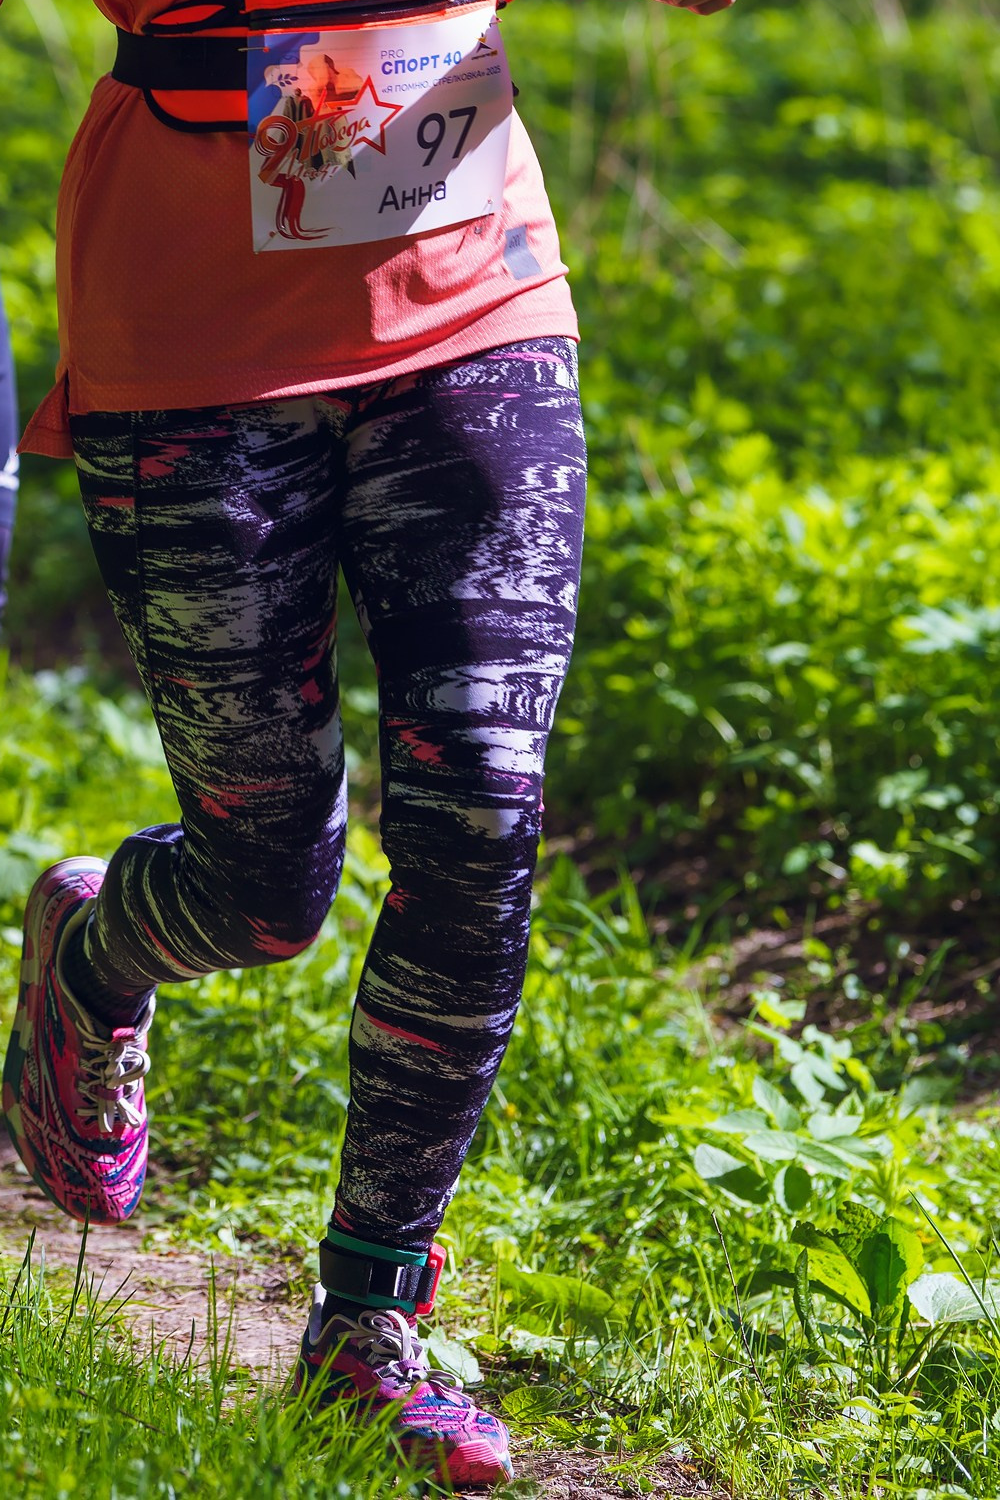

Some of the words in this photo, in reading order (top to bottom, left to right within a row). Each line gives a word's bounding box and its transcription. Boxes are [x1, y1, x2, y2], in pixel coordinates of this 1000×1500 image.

[380, 49, 404, 60] PRO
[381, 54, 440, 76] СПОРТ
[443, 51, 462, 66] 40
[486, 65, 502, 77] 2025
[416, 105, 478, 167] 97
[377, 180, 447, 214] Анна
